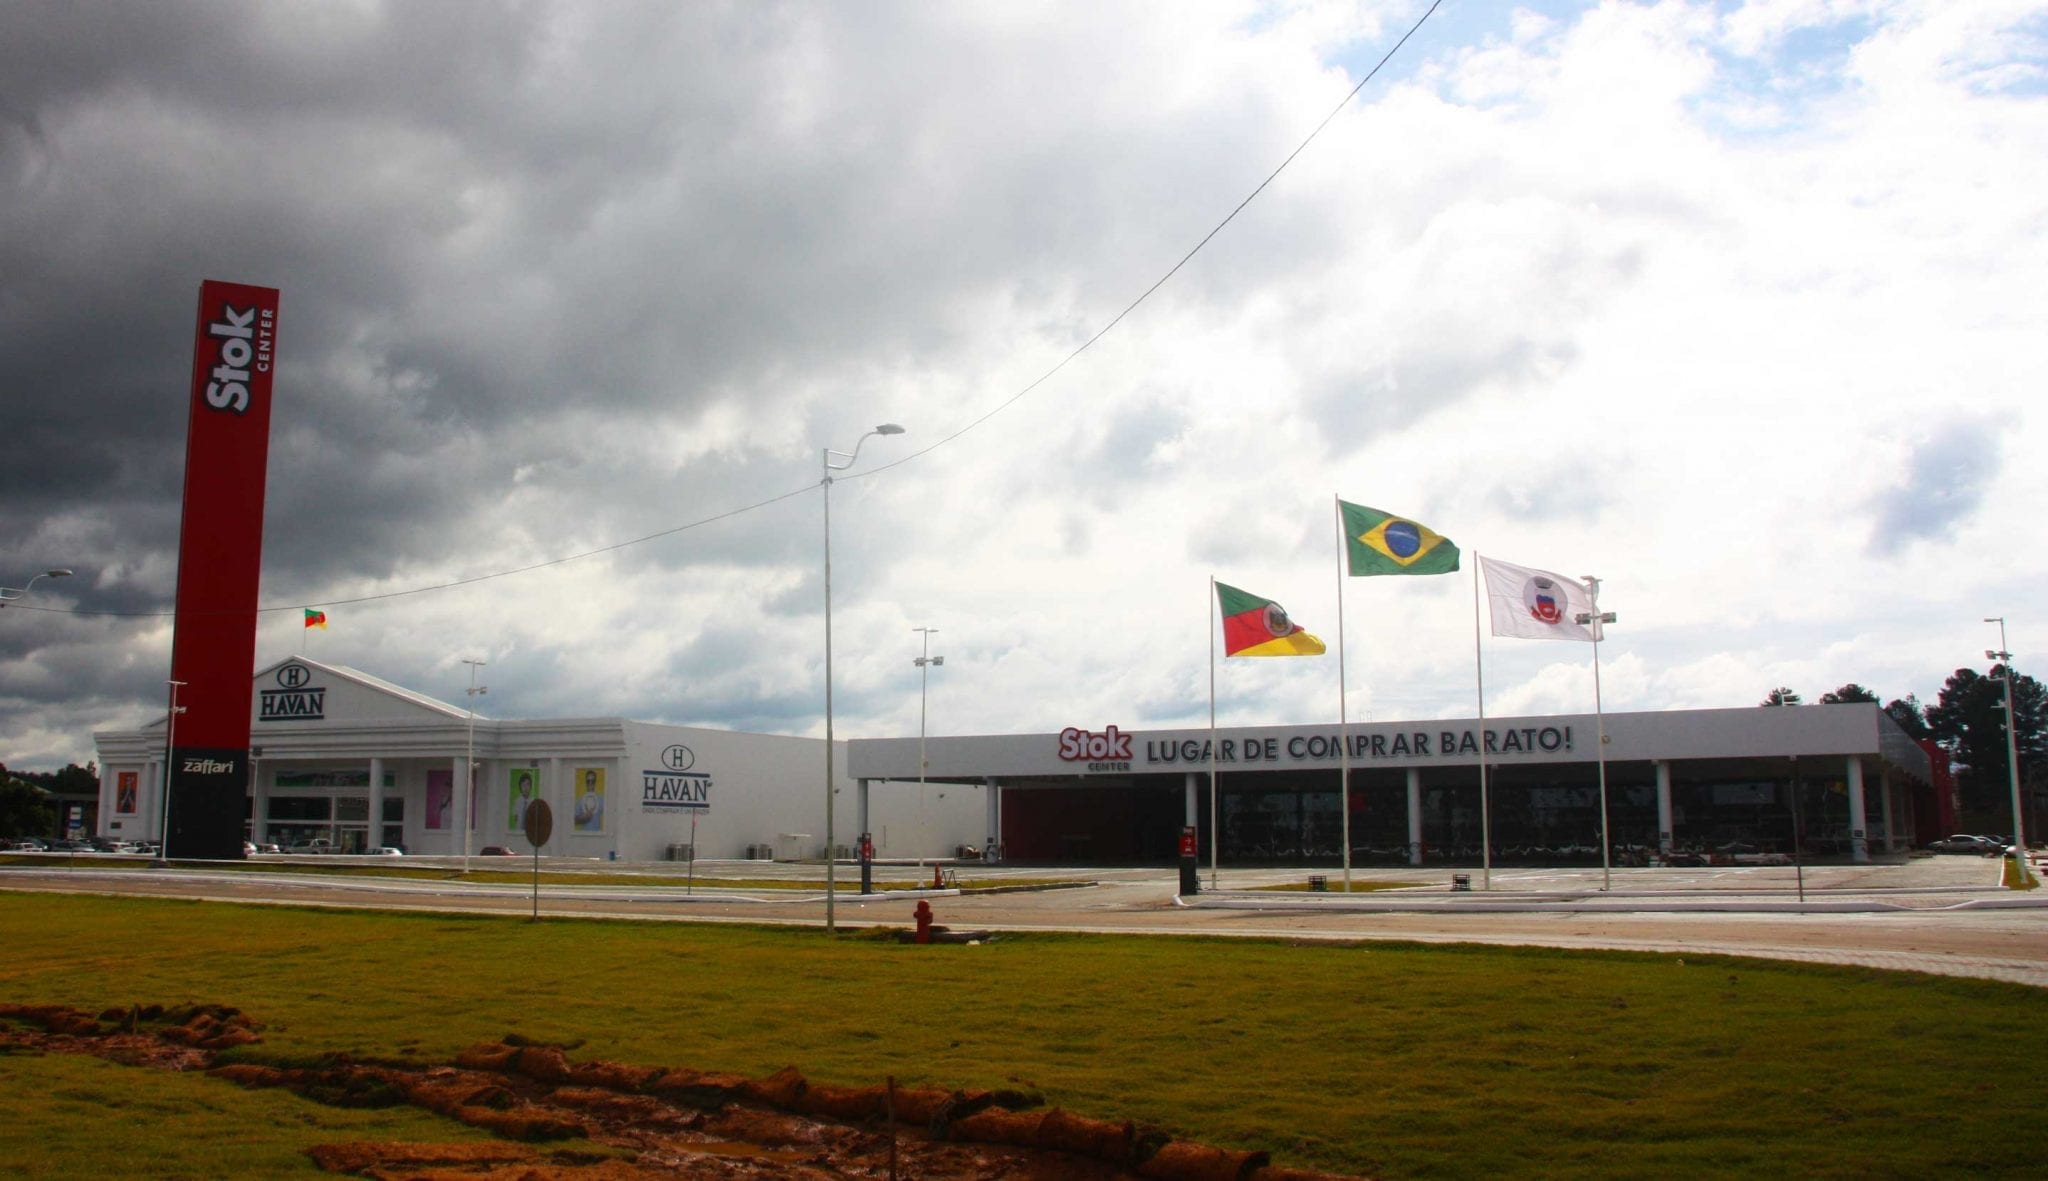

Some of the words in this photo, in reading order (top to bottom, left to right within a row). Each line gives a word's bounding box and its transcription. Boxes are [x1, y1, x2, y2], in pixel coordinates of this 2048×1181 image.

[257, 309, 273, 372] CENTER
[205, 304, 255, 412] Stok
[261, 693, 324, 716] HAVAN
[1059, 725, 1133, 761] Stok
[1147, 739, 1235, 763] LUGAR
[1243, 738, 1278, 760] DE
[1287, 734, 1430, 759] COMPRAR
[1440, 726, 1573, 755] BARATO!
[183, 759, 234, 774] zaffari
[1088, 762, 1131, 771] CENTER
[643, 777, 708, 801] HAVAN
